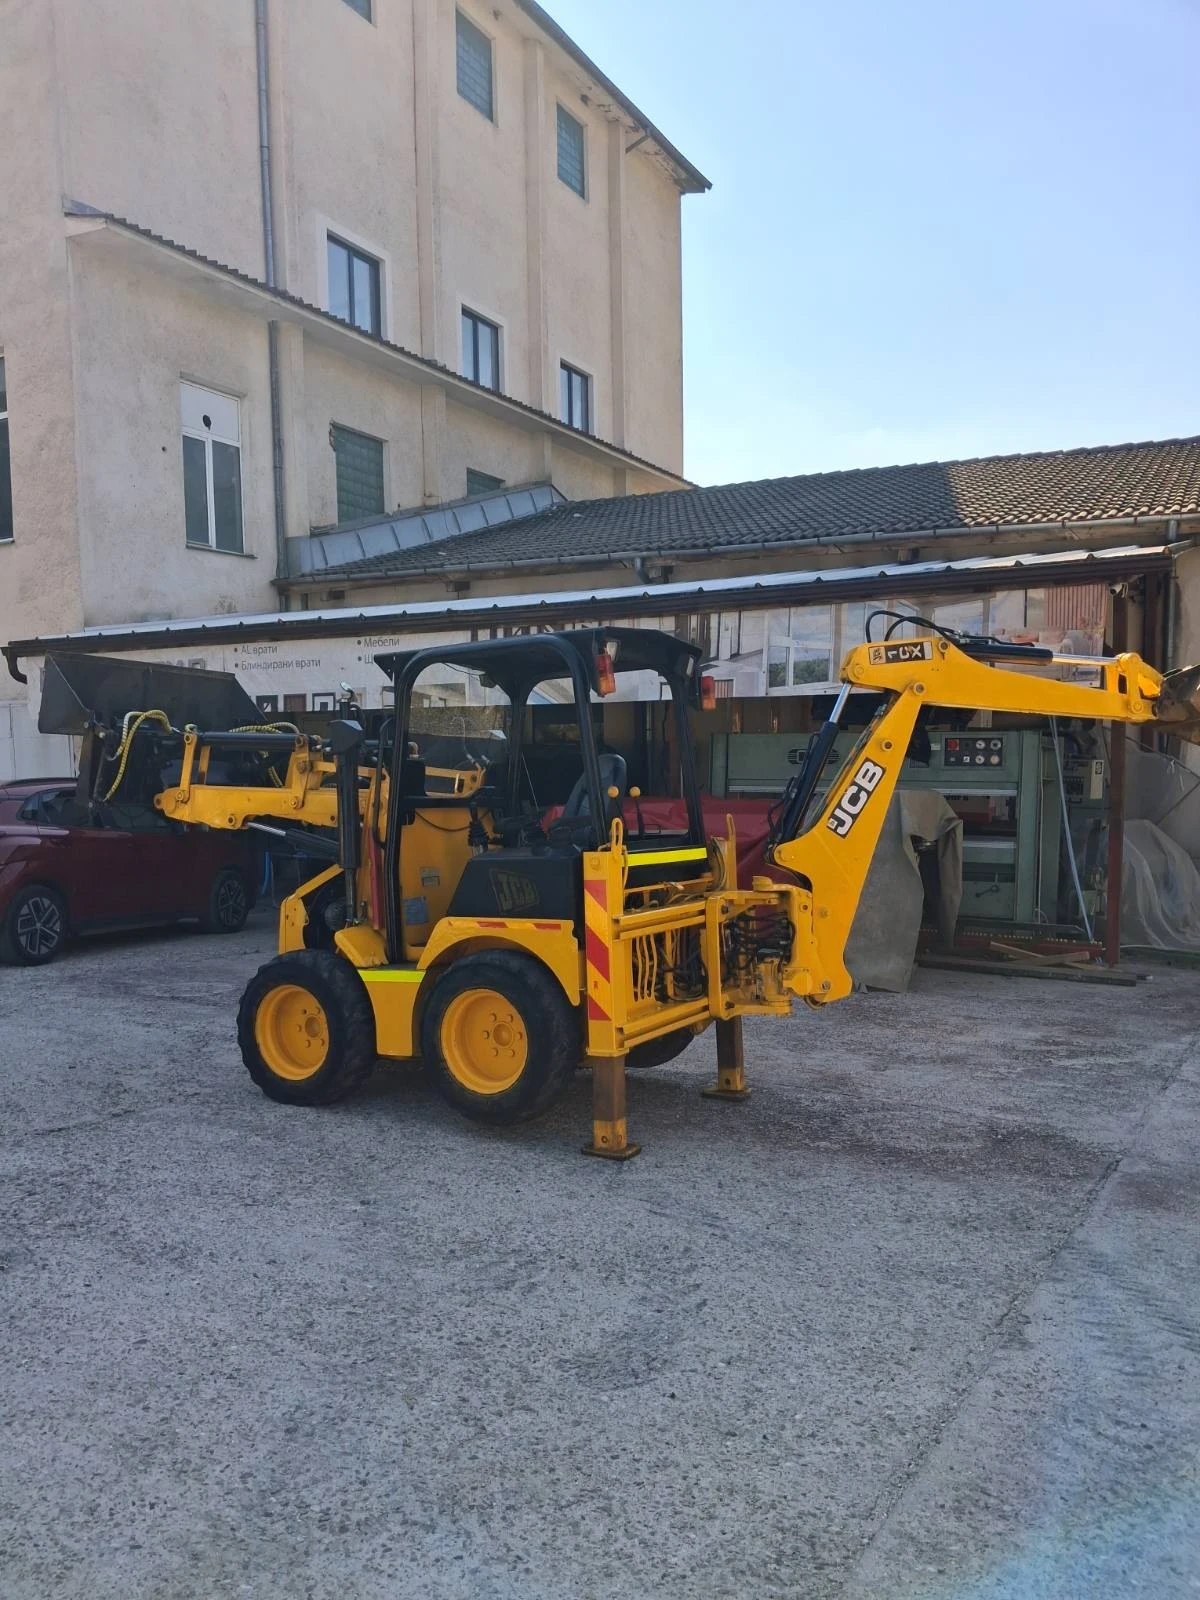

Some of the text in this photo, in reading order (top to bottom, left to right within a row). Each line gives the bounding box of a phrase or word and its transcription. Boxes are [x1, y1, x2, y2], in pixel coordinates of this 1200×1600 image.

[363, 638, 400, 648] Мебели
[253, 646, 278, 656] врати
[241, 659, 321, 671] Блиндирани врати
[833, 761, 883, 835] JCB
